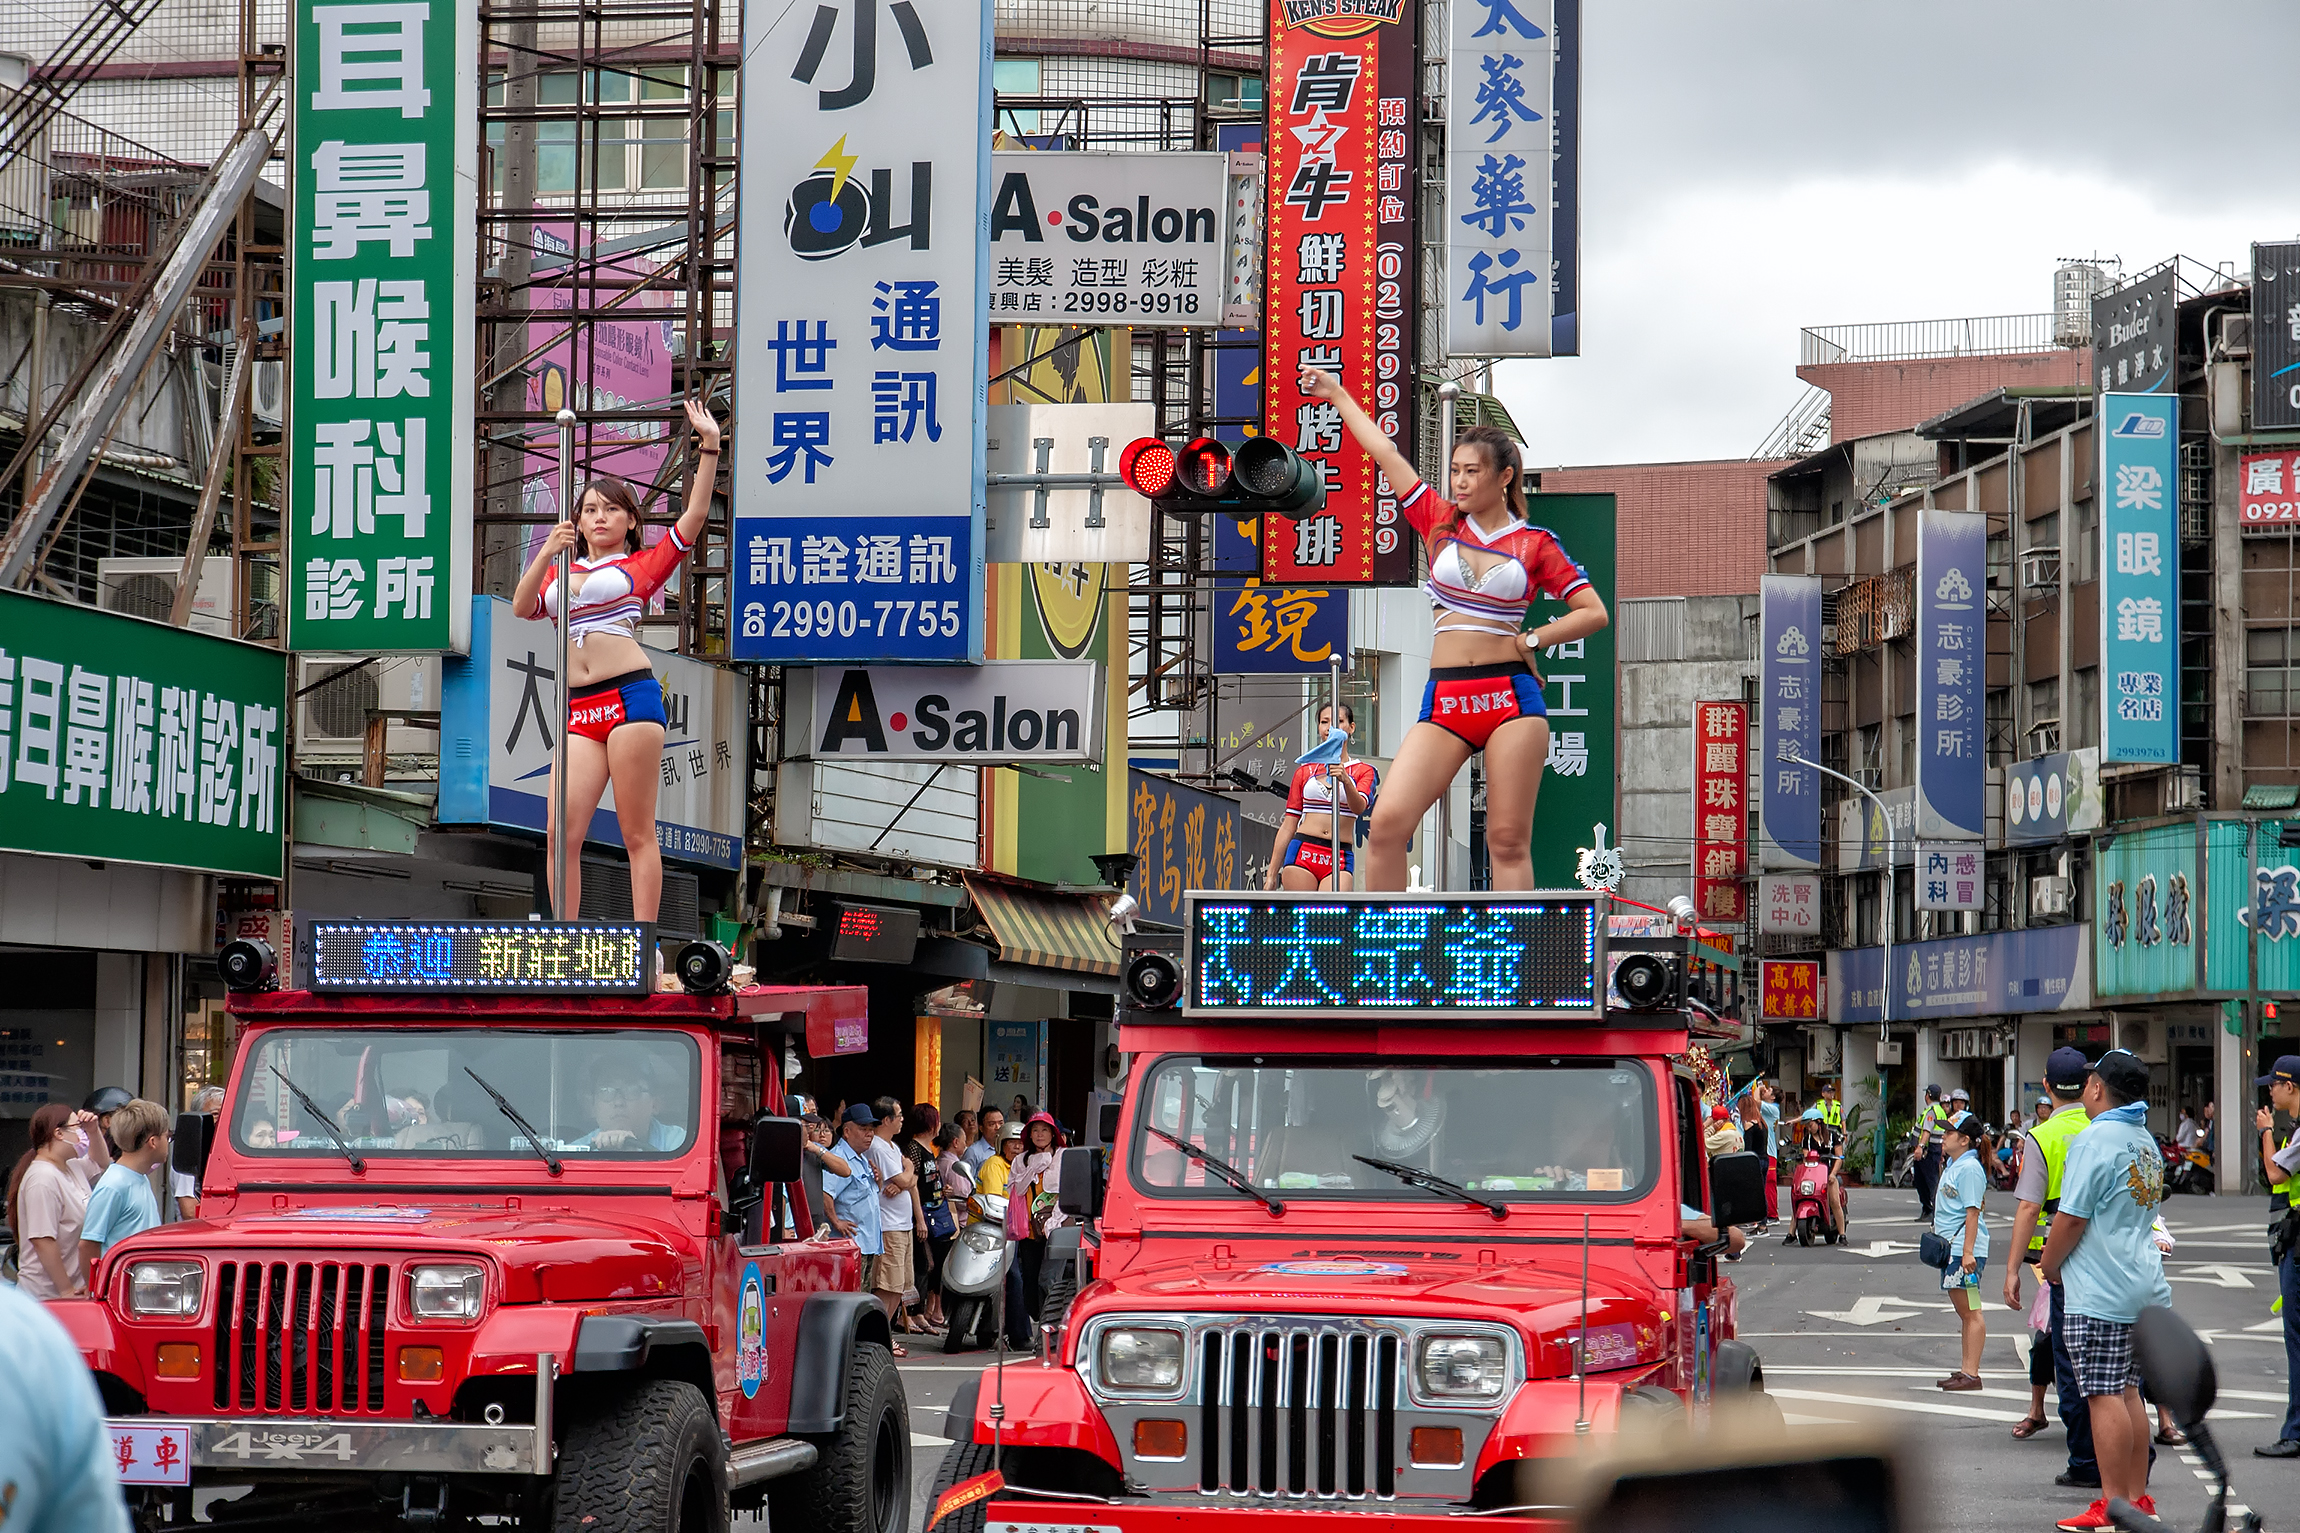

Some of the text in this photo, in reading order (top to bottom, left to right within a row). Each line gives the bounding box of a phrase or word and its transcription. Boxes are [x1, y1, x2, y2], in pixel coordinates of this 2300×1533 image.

[1341, 0, 1400, 20] STEAK
[311, 2, 432, 540] 耳鼻喉科
[997, 257, 1055, 287] 美髮
[1070, 258, 1128, 288] 造型
[1064, 292, 1199, 315] 2998-9918
[1375, 98, 1406, 555] 預約訂位 (02)2996559
[2109, 311, 2150, 349] Buder
[870, 279, 942, 445] 通訊
[766, 320, 838, 485] 世界
[749, 535, 957, 585] 訊詮通訊
[2116, 463, 2163, 643] 梁眼鏡
[305, 556, 435, 621] 診所
[773, 600, 960, 638] 2990-7755
[1440, 690, 1513, 714] PINK
[1936, 623, 1964, 758] 志豪診所
[2117, 671, 2162, 695] 專業
[570, 703, 620, 725] PINK
[2117, 698, 2162, 721] 名店
[1704, 706, 1739, 917] 群麗珠寶銀樓
[1927, 853, 1948, 904] 內科
[1955, 853, 1976, 904] 感冒
[1771, 907, 1812, 927] 中心
[363, 933, 453, 978] 恭迎
[1927, 946, 1988, 991] 志豪診所
[252, 1431, 323, 1447] Jeep
